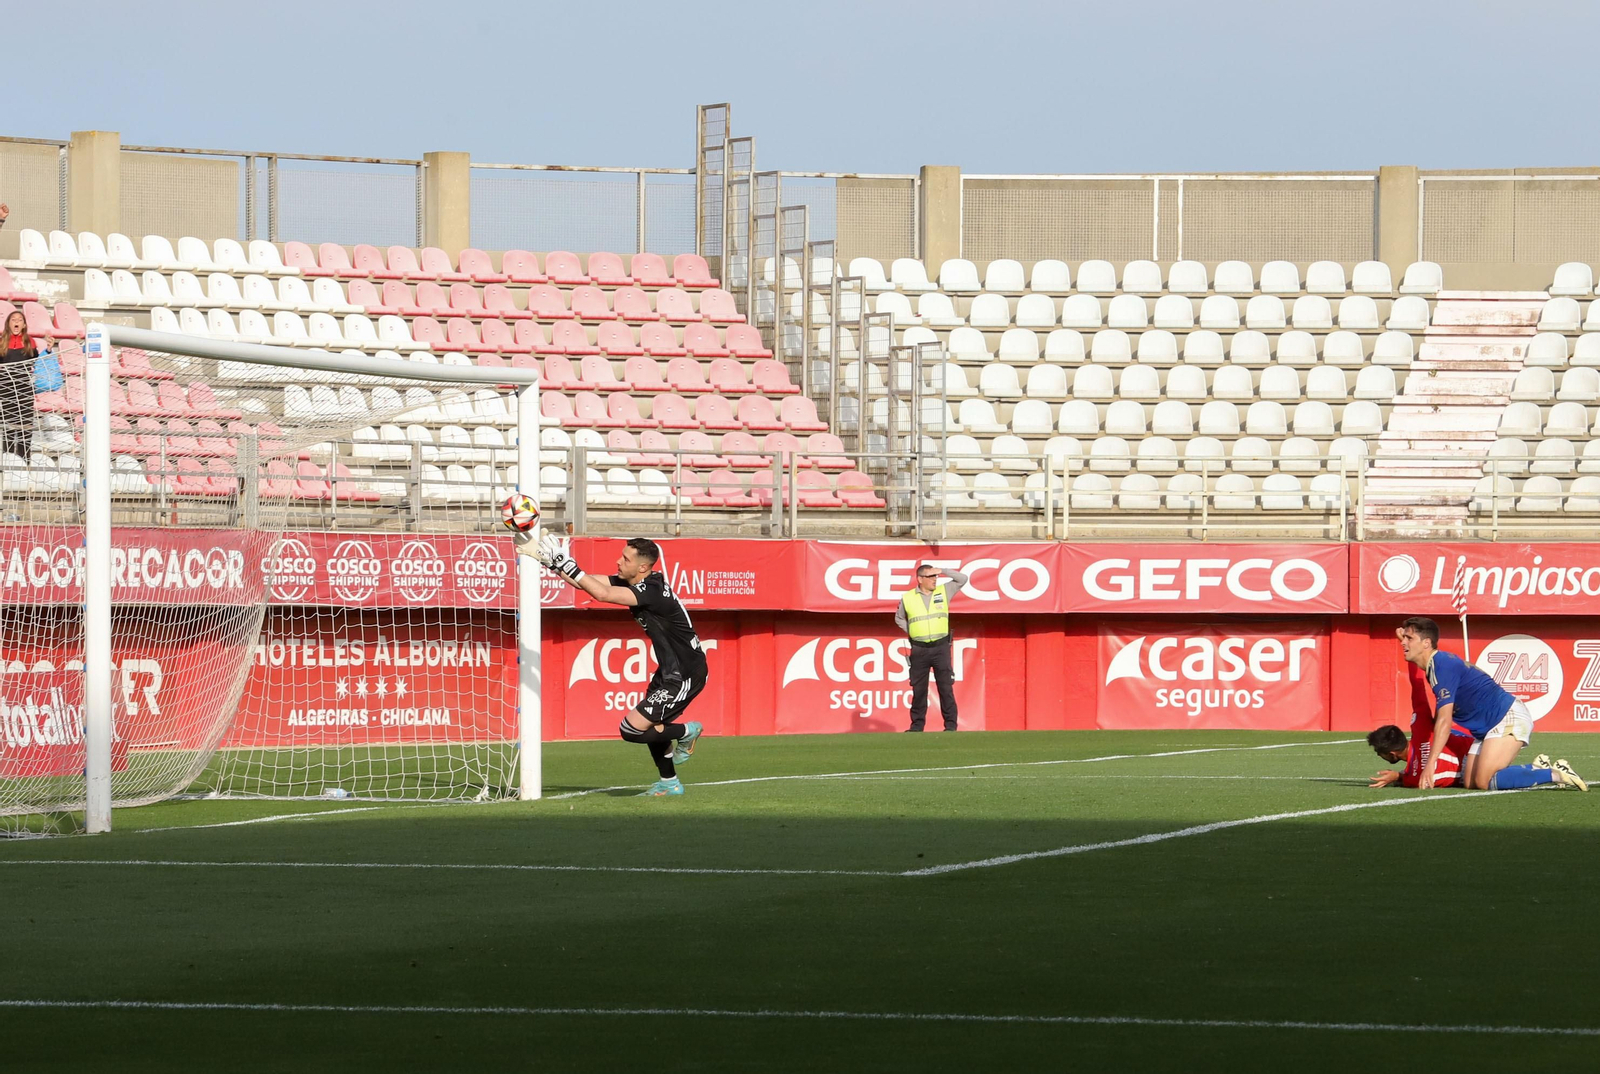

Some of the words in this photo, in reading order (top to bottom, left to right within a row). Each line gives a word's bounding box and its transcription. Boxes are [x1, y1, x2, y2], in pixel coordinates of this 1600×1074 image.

[261, 557, 316, 574] COSCO
[327, 558, 381, 575] COSCO
[391, 559, 445, 576] COSCO
[455, 560, 508, 577] COSCO
[263, 575, 314, 586] SHIPPING
[329, 576, 379, 587] SHIPPING
[393, 576, 443, 588] SHIPPING
[457, 577, 505, 588] SHIPPING
[707, 570, 755, 580] DISTRIBUCIÓN
[707, 579, 716, 587] DE
[719, 579, 748, 587] BEBIDAS
[1082, 558, 1328, 601] GEFCO
[707, 586, 755, 595] ALIMENTACIÓN
[249, 634, 365, 667] HOTELES
[374, 632, 490, 668] ALBORÁN
[600, 638, 718, 683] car
[822, 638, 977, 683] casr
[1148, 637, 1316, 682] caser
[830, 689, 930, 717] seguro
[1156, 688, 1265, 717] seguros
[288, 709, 368, 727] ALGECIRAS
[380, 709, 451, 727] CHICLANA
